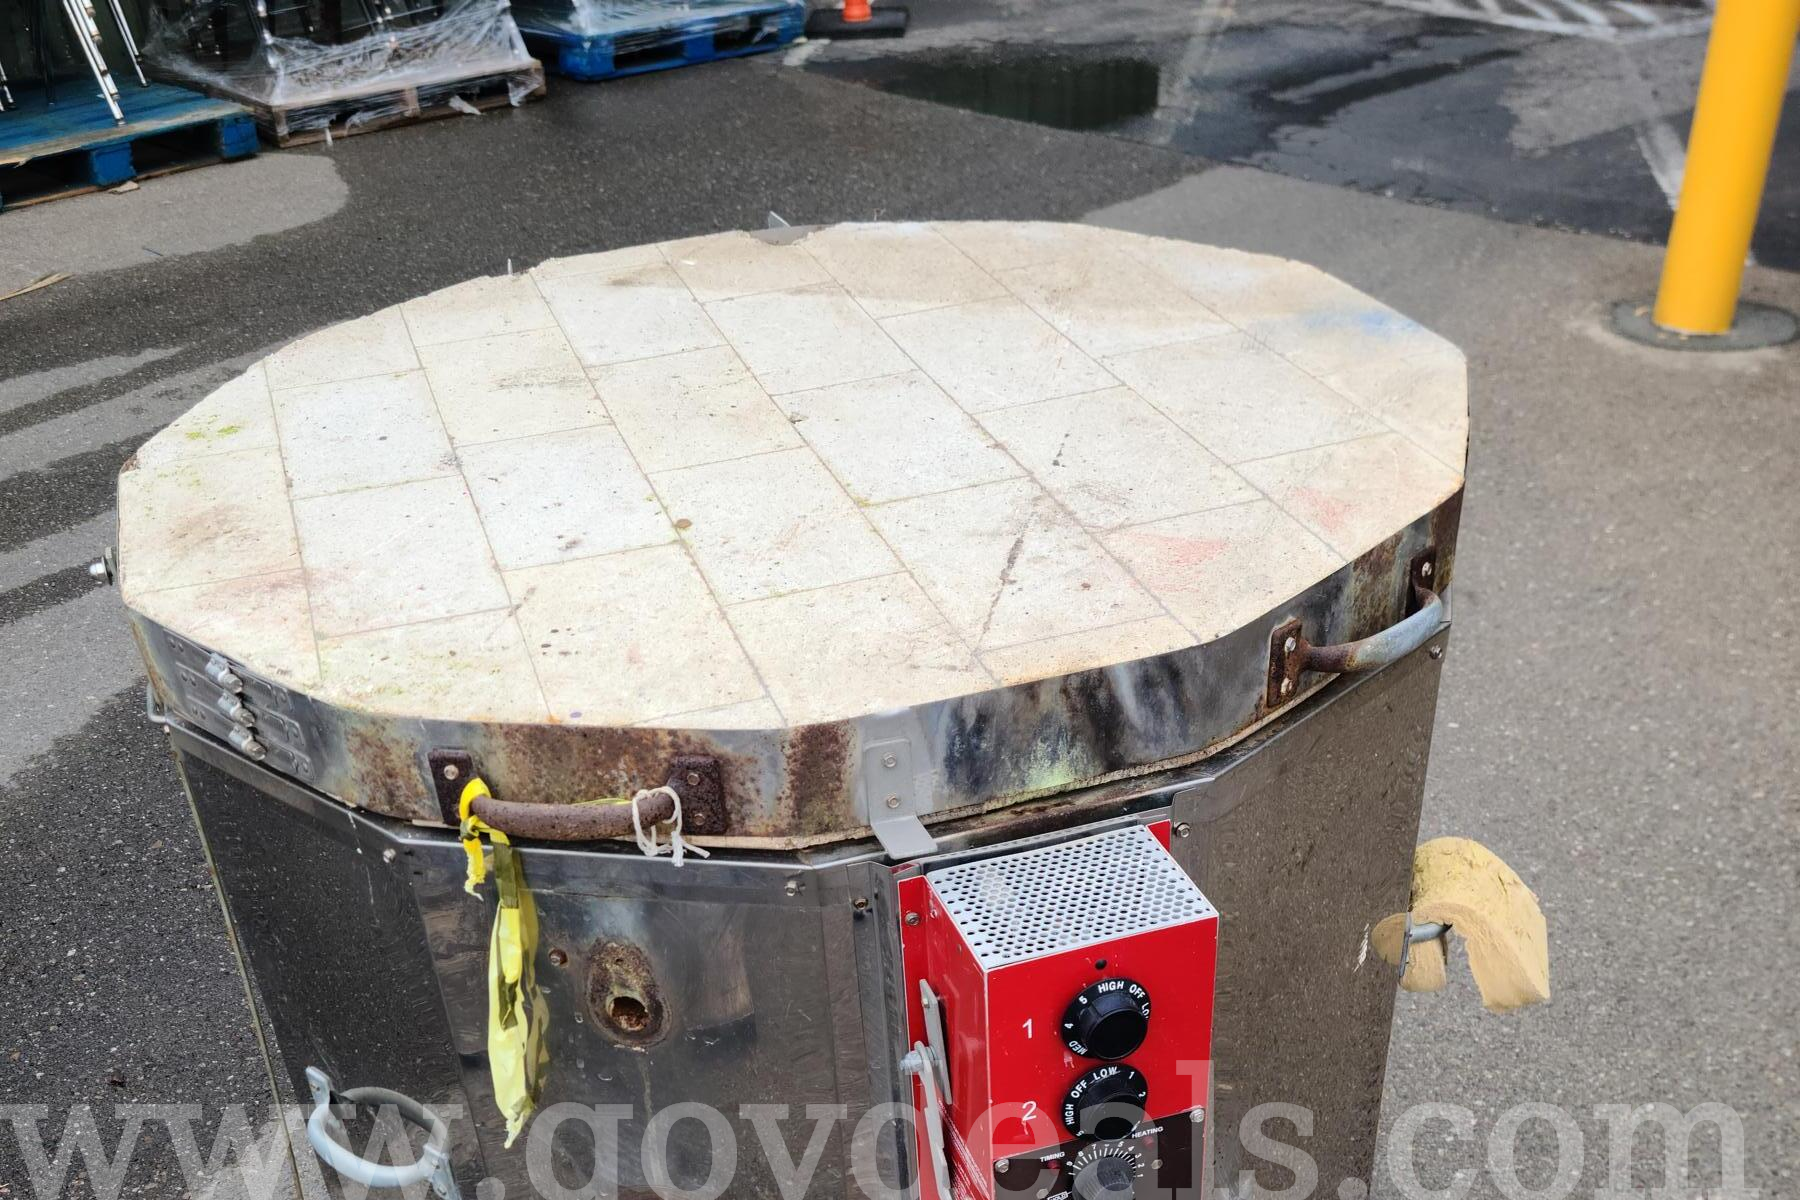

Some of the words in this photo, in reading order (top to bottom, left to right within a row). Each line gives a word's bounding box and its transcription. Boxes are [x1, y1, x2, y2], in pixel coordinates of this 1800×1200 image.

[1079, 996, 1088, 1005] 5
[1097, 981, 1124, 993] HIGH
[1129, 984, 1146, 999] OFF
[1141, 1002, 1150, 1019] LO
[1022, 1018, 1033, 1039] 1
[1064, 1022, 1074, 1030] 4
[1068, 1040, 1088, 1055] MED
[1129, 1071, 1135, 1079] 1
[1065, 1104, 1075, 1126] HIGH
[1071, 1080, 1088, 1099] OFF
[1093, 1066, 1119, 1081] LOW
[1022, 1101, 1037, 1121] 2
[1131, 1126, 1164, 1139] HEATING
[1040, 1151, 1065, 1163] TIMING
